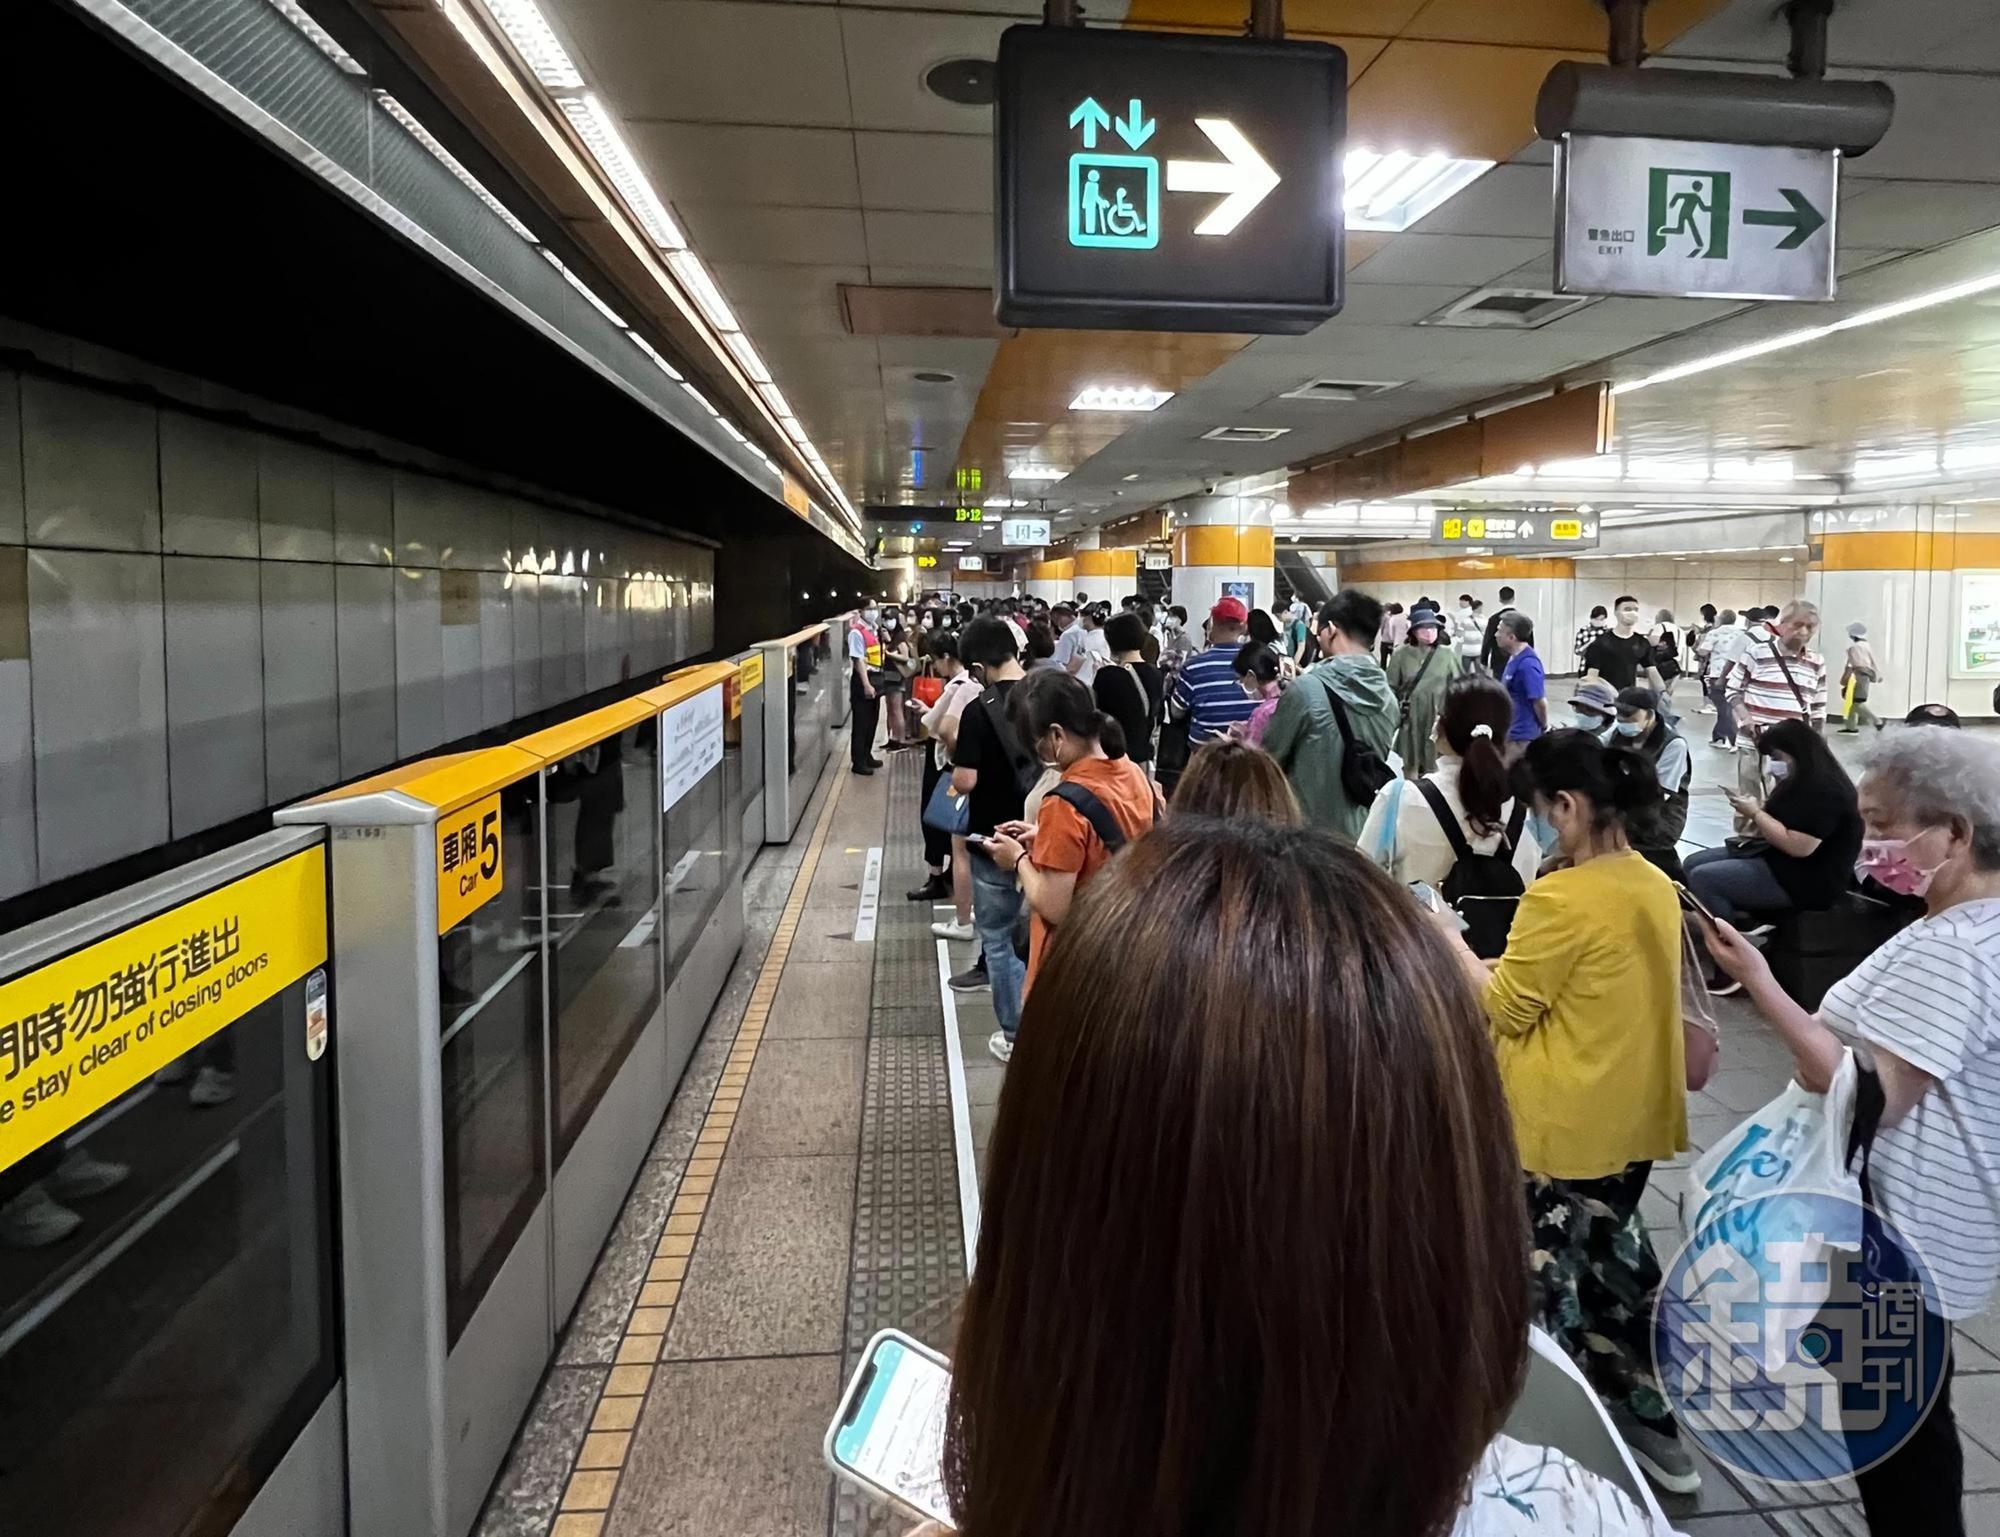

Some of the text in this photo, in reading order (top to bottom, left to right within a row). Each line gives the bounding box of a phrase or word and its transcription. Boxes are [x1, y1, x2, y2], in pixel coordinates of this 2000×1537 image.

[1598, 245, 1623, 255] EXIT
[956, 508, 981, 521] 13:12
[443, 809, 498, 880] 車廂 5
[460, 872, 478, 896] Car
[22, 1063, 73, 1110] stay
[79, 1029, 131, 1076] clear
[136, 1011, 156, 1041] of
[159, 979, 221, 1028] closing
[226, 953, 268, 988] doors
